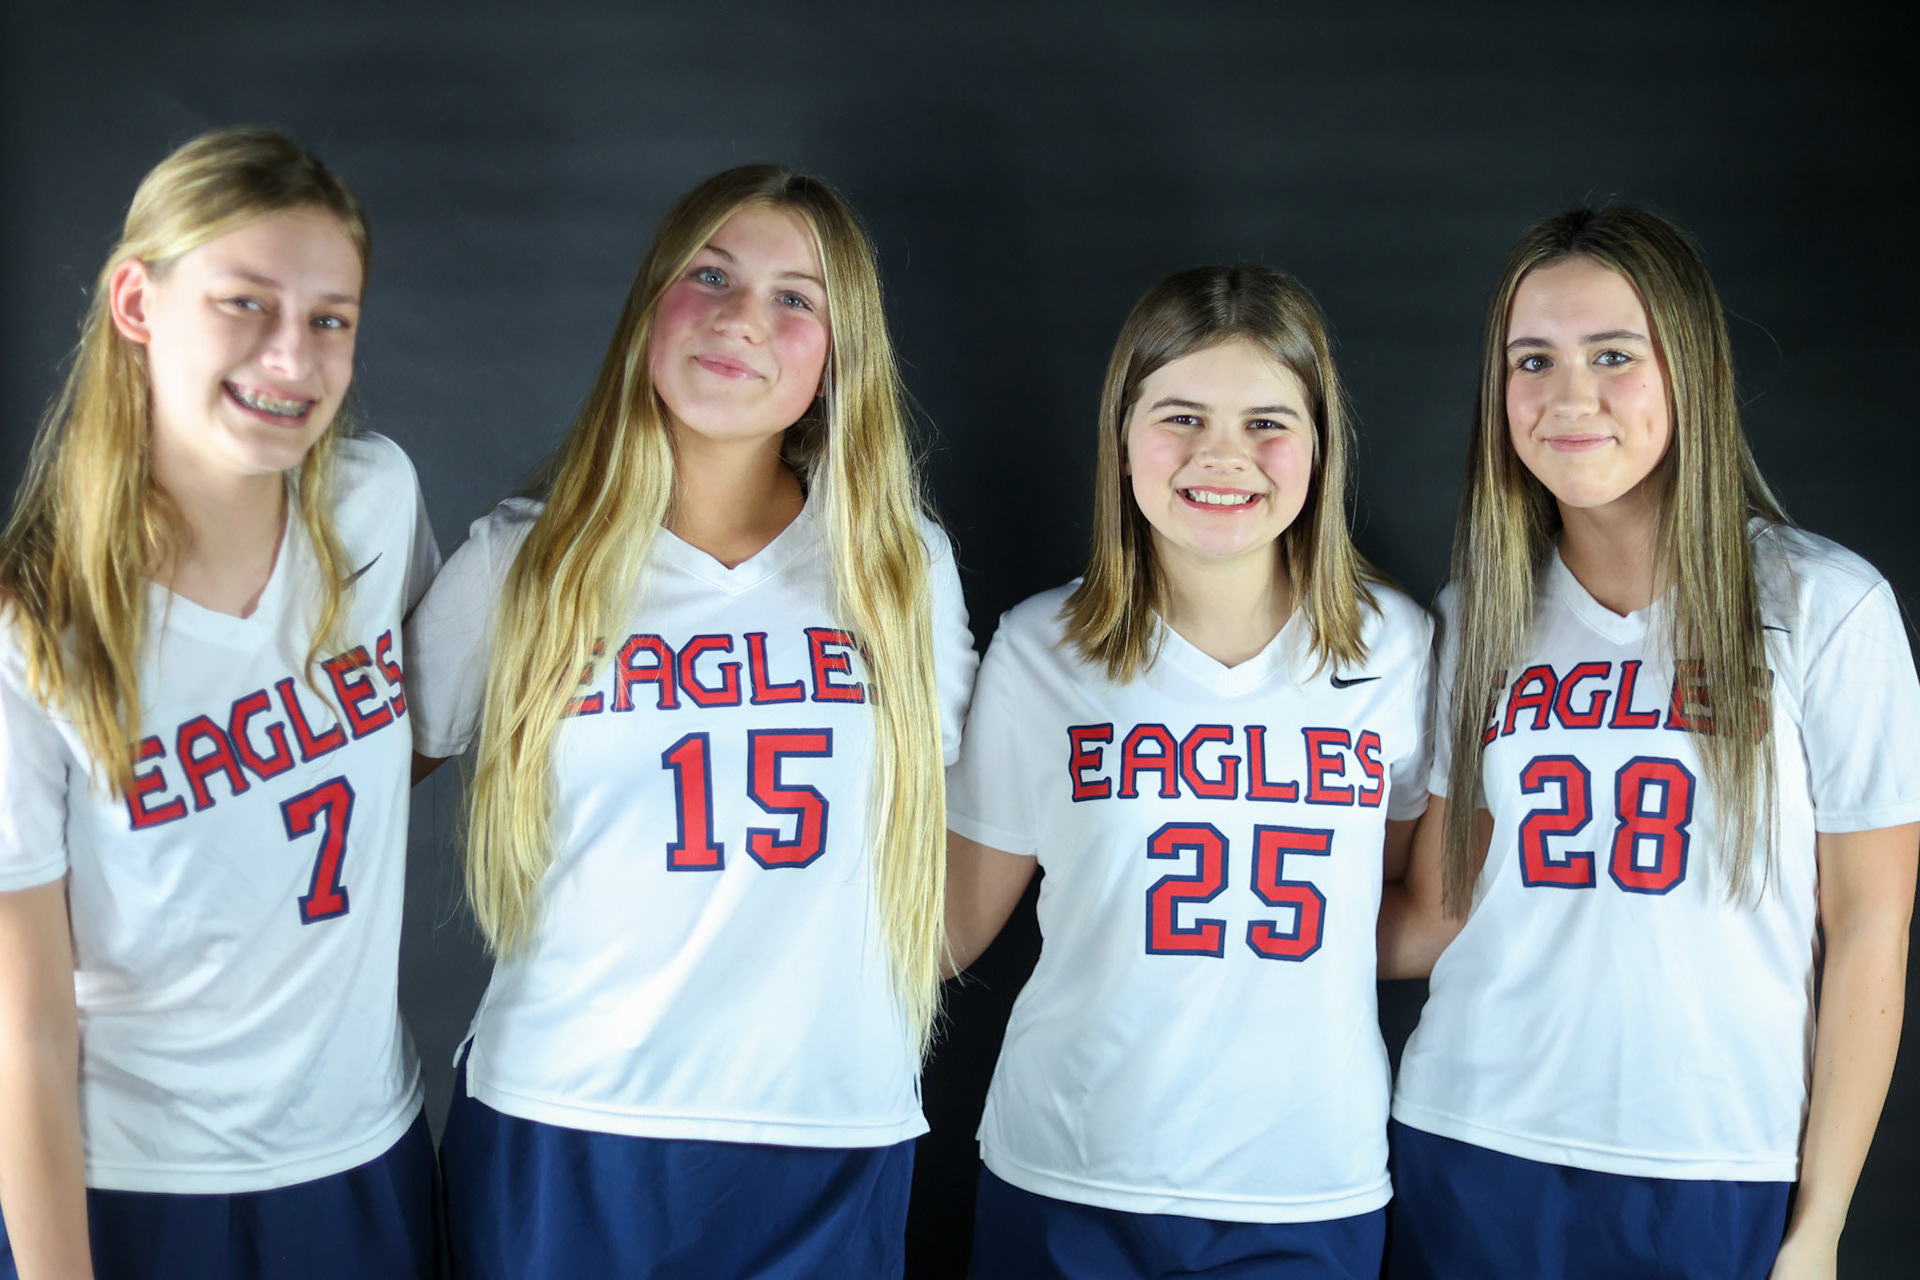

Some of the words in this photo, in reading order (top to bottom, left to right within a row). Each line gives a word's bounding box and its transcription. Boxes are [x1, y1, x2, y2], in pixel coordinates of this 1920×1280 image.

[126, 628, 406, 830] EAGLES
[661, 727, 833, 872] 15
[1067, 722, 1384, 808] EAGLES
[279, 774, 356, 925] 7
[1145, 821, 1335, 962] 25
[1518, 754, 1696, 895] 28
